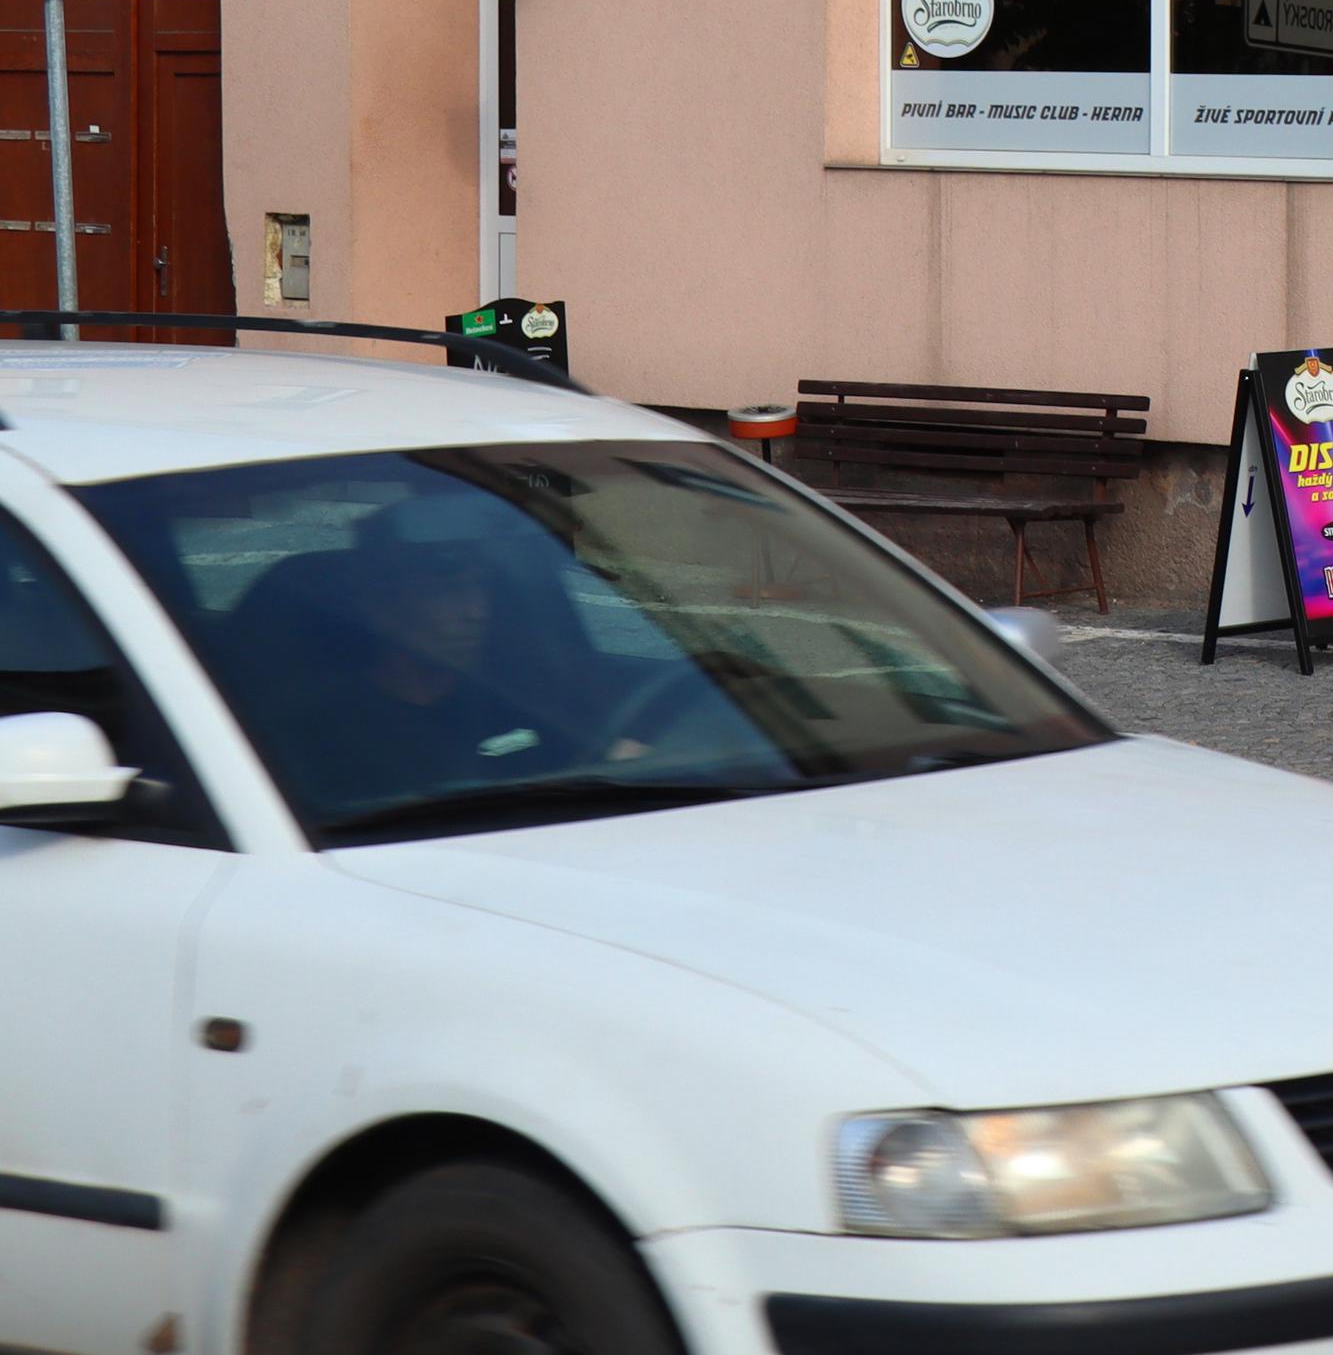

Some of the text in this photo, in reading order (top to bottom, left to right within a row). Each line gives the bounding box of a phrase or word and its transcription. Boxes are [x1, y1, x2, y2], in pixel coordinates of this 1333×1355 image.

[901, 100, 942, 118] PIVNÍ
[945, 103, 977, 118] BAR
[987, 104, 1037, 120] MUSIC
[1040, 105, 1079, 121] CLUB
[1090, 106, 1143, 122] HERNA
[1194, 105, 1231, 123] ŽIVÉ
[1234, 106, 1325, 125] SPORTOVNÍ
[1297, 473, 1333, 488] každý
[1311, 492, 1319, 502] a
